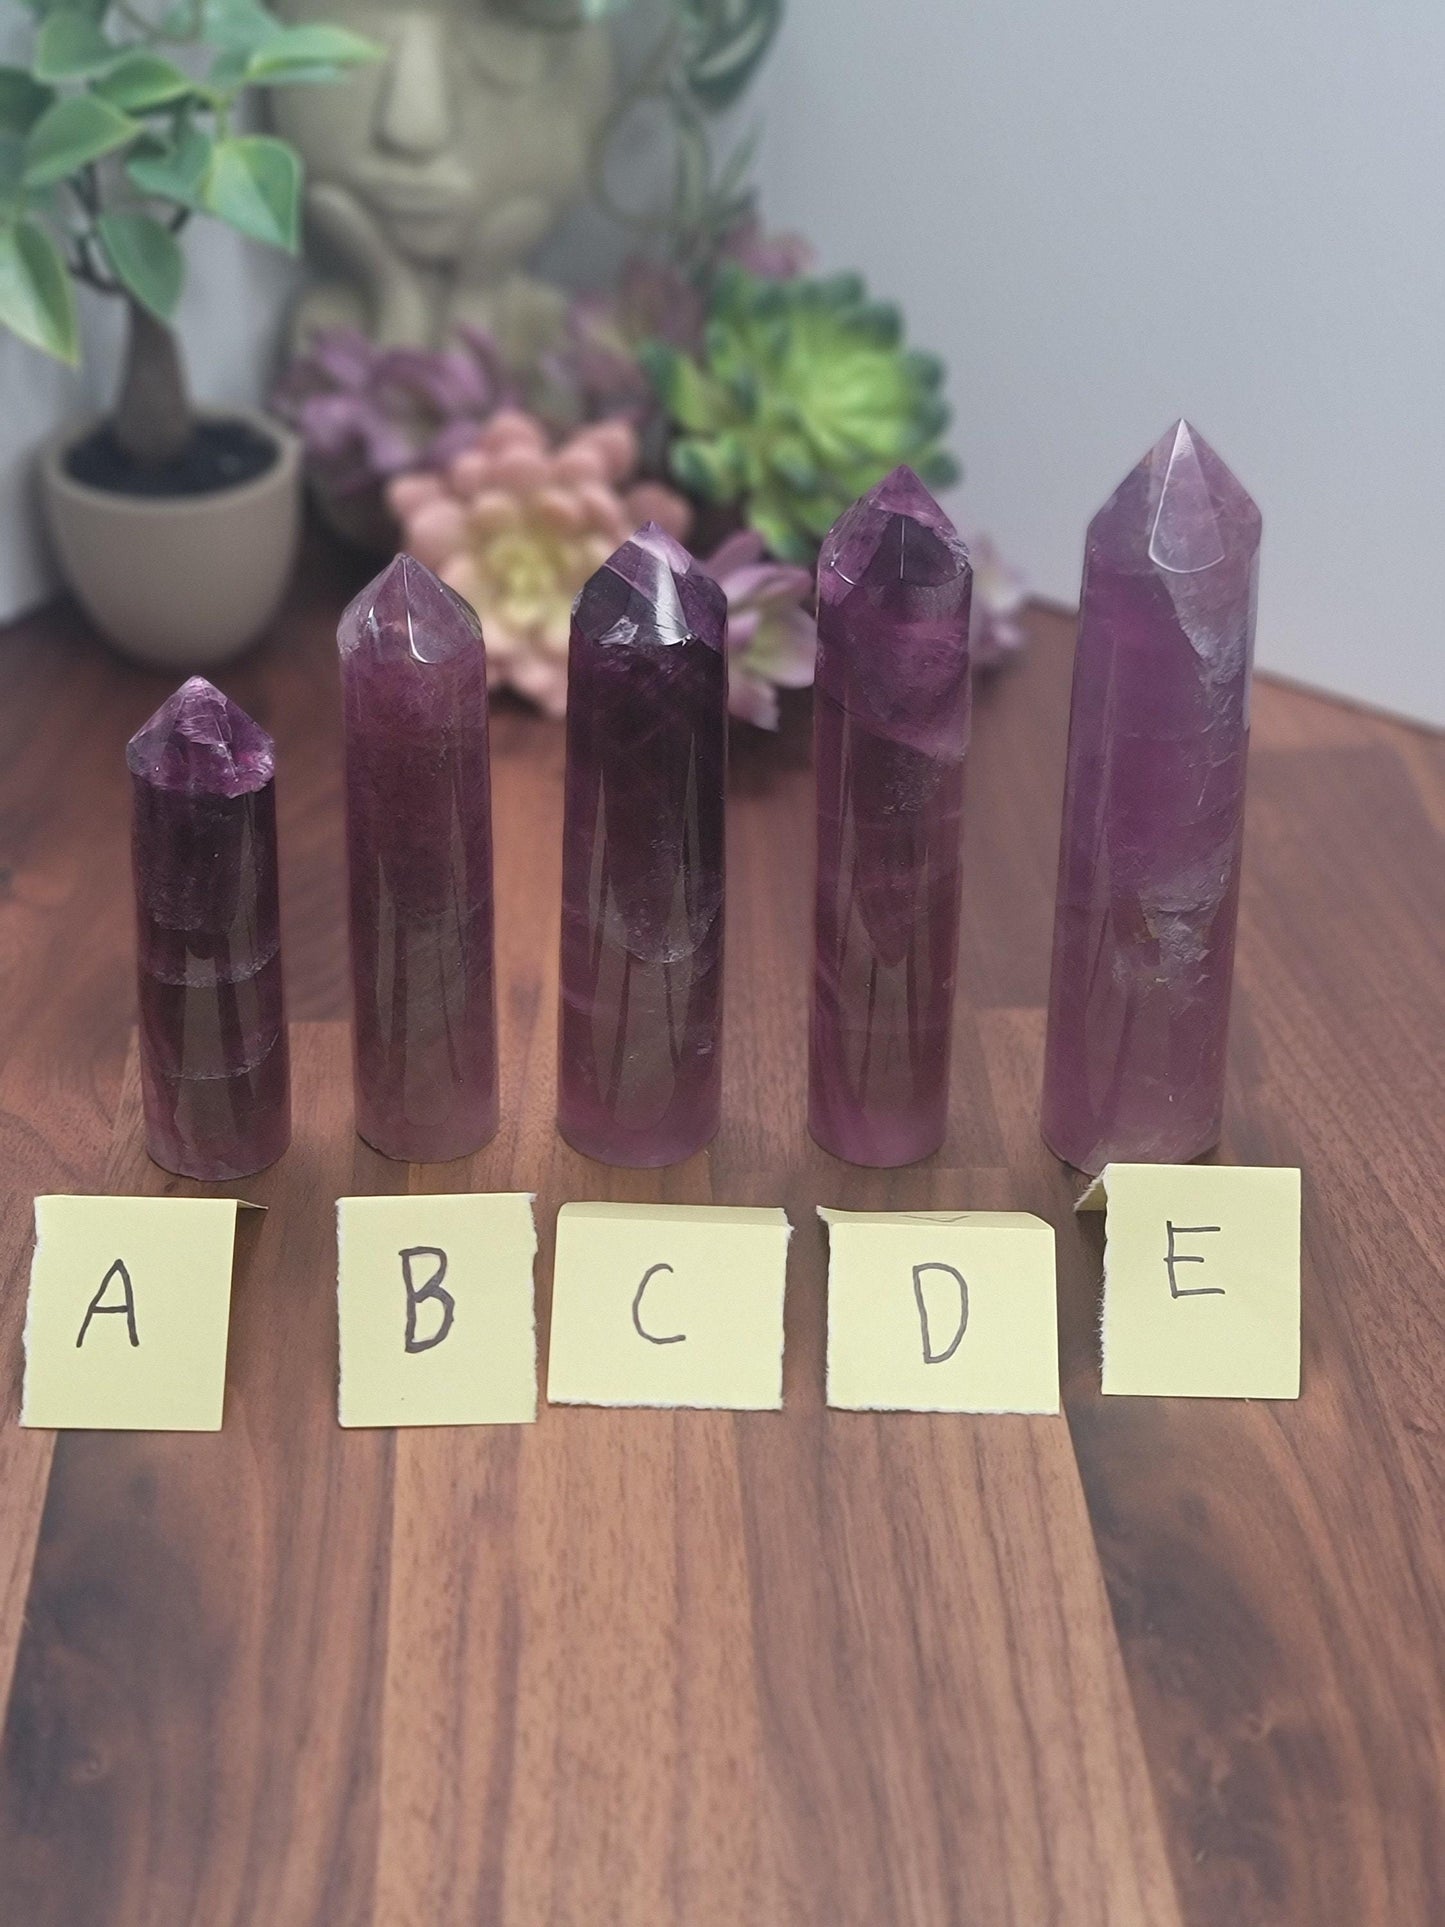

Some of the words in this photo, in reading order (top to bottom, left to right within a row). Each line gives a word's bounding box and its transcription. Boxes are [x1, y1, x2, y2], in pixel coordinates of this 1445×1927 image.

[76, 1258, 140, 1348] A
[398, 1246, 455, 1353] B
[632, 1263, 686, 1345] C
[1164, 1221, 1226, 1299] E
[912, 1263, 969, 1364] D
